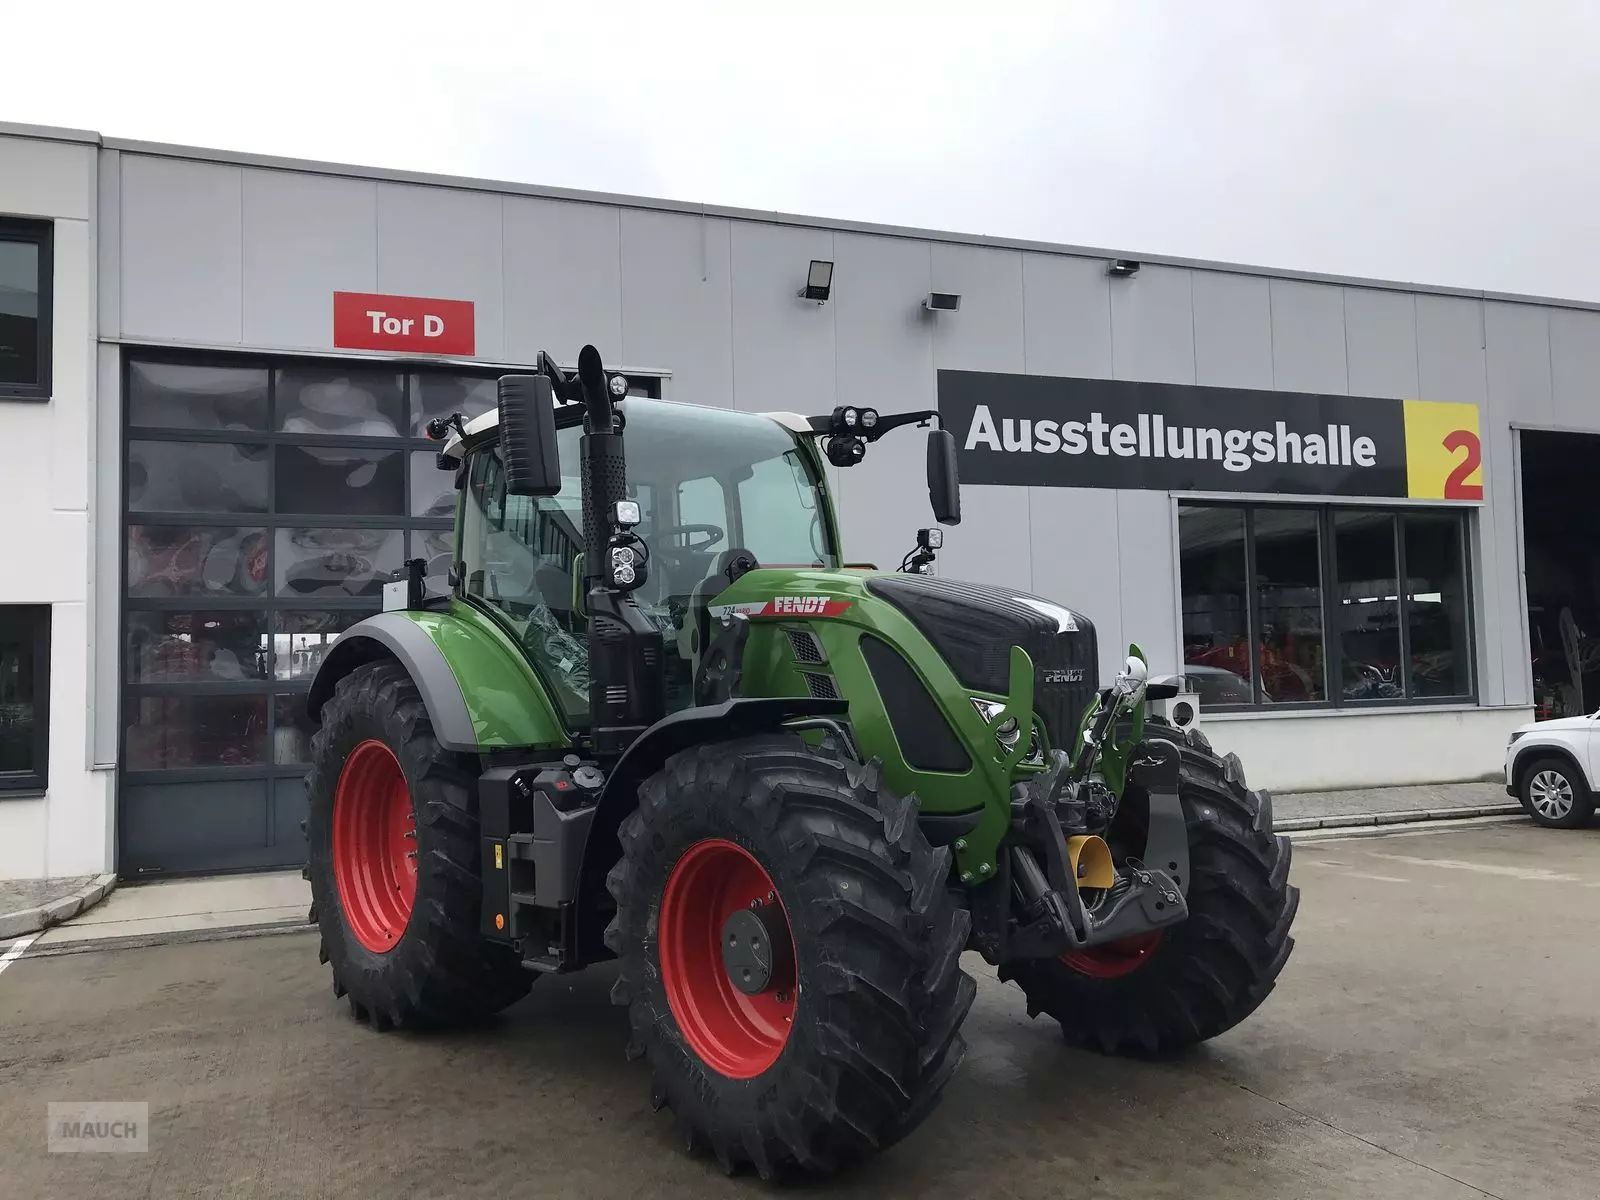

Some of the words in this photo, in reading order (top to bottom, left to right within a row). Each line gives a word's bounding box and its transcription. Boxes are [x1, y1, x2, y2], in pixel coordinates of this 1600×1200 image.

[366, 310, 415, 336] Tor
[423, 314, 445, 337] D
[964, 404, 1377, 472] Ausstellungshalle
[1442, 429, 1483, 500] 2
[774, 596, 831, 613] FENDT
[1043, 669, 1085, 683] FENDT
